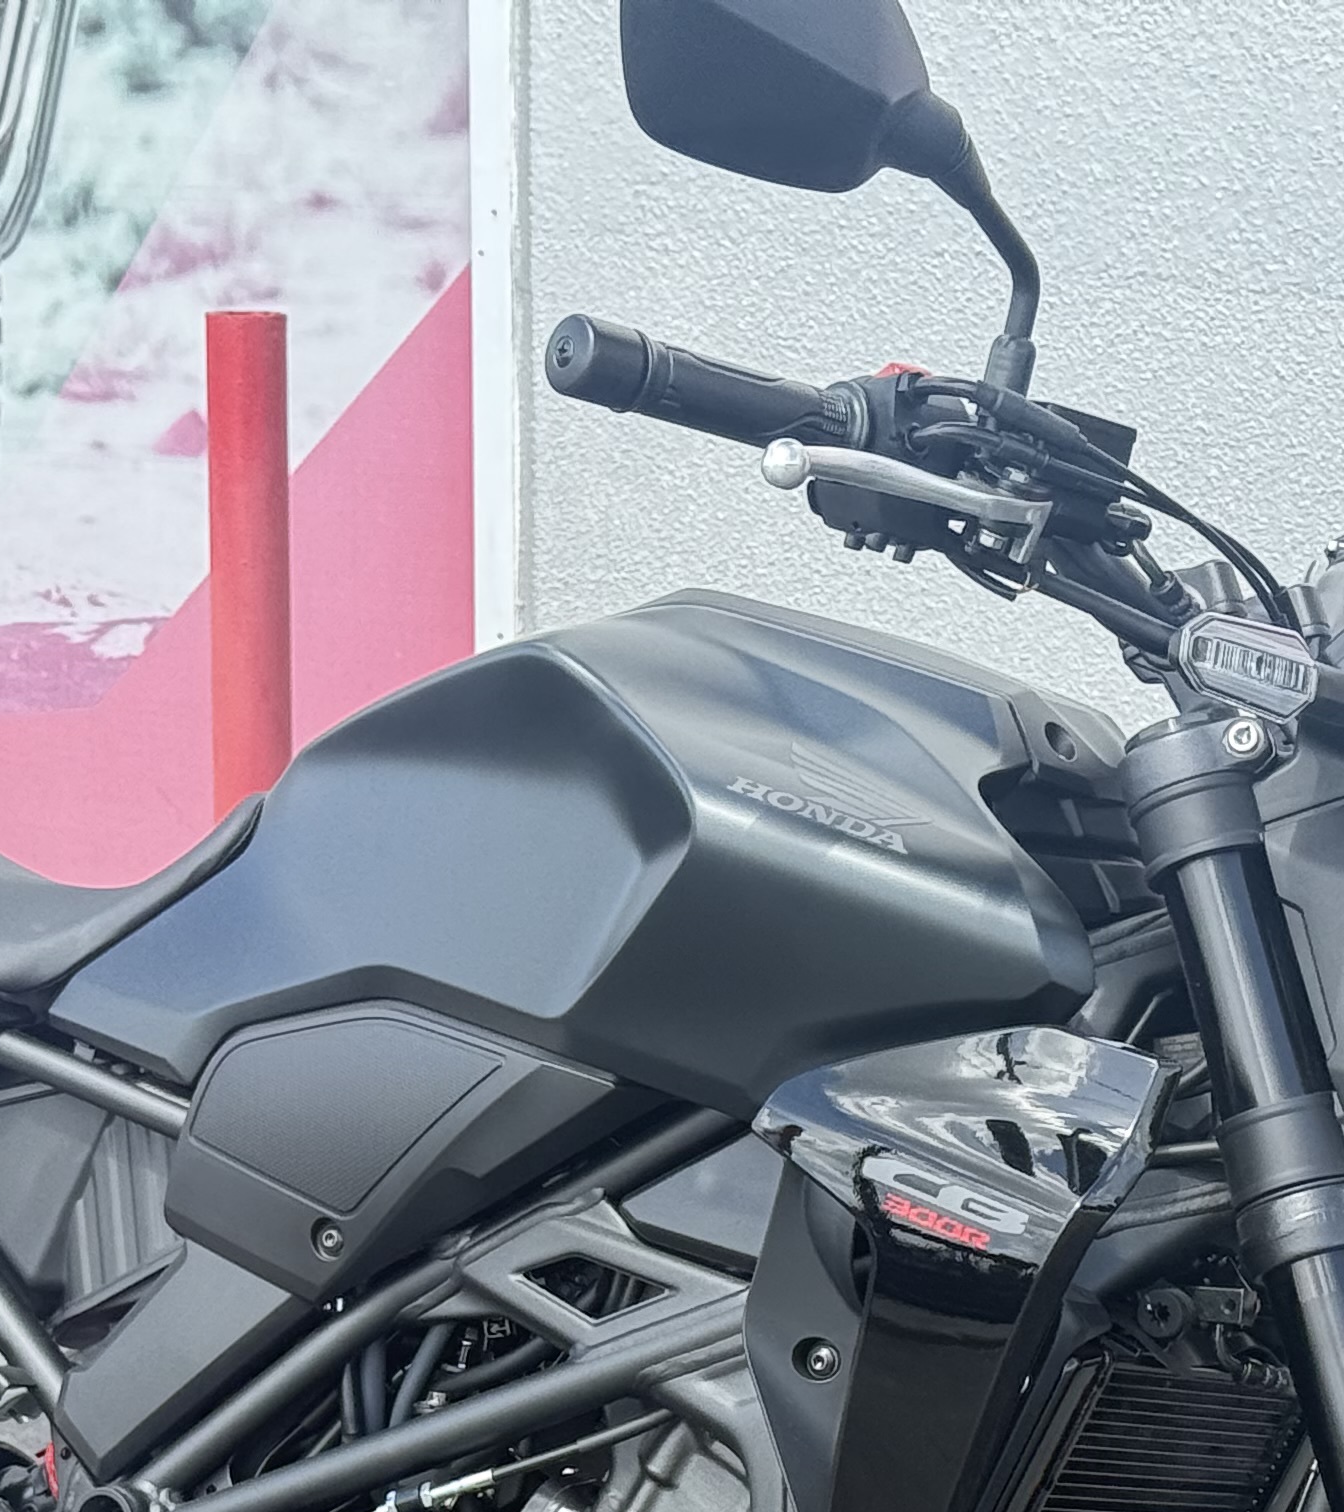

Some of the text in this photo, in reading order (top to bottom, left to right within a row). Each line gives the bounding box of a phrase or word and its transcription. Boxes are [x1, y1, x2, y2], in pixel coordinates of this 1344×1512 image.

[726, 776, 908, 855] HONDA
[862, 1157, 1030, 1235] CB
[881, 1192, 991, 1250] 300R
